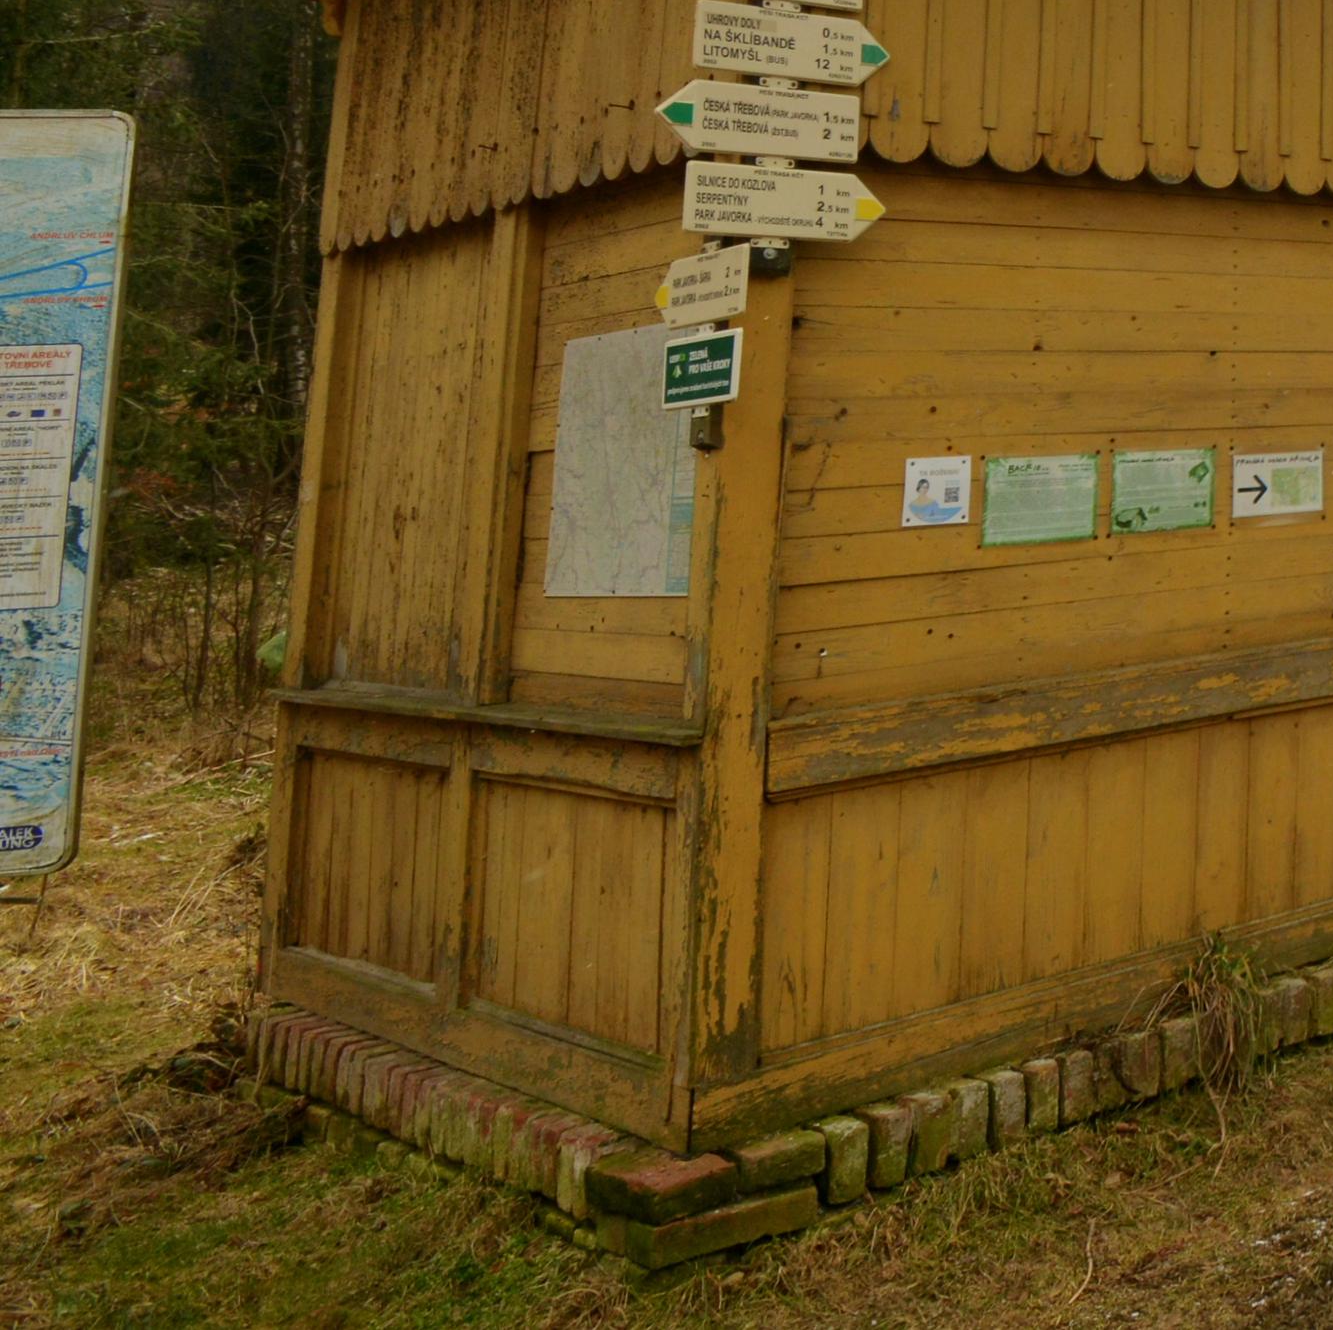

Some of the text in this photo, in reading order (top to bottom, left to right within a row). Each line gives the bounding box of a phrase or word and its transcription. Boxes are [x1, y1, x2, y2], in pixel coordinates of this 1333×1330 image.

[704, 29, 721, 41] NA
[840, 32, 855, 42] km
[703, 45, 763, 62] LITOMYŠL
[839, 48, 854, 58] km
[815, 58, 853, 72] 12 km
[703, 97, 730, 112] ČESKÁ
[733, 100, 770, 117] TŘEBOVÁ
[702, 117, 729, 131] ČESKÁ
[732, 119, 769, 135] TŘEBOVÁ
[841, 116, 855, 125] km
[822, 128, 855, 142] 2 km
[697, 175, 776, 192] SILNICE DO KOZLOVA
[818, 184, 850, 198] 1 km
[696, 192, 749, 207] SERPENTÝNY
[695, 208, 715, 221] PARK
[716, 210, 752, 223] JAVORKA
[835, 205, 849, 214] km
[815, 217, 848, 230] 4 km
